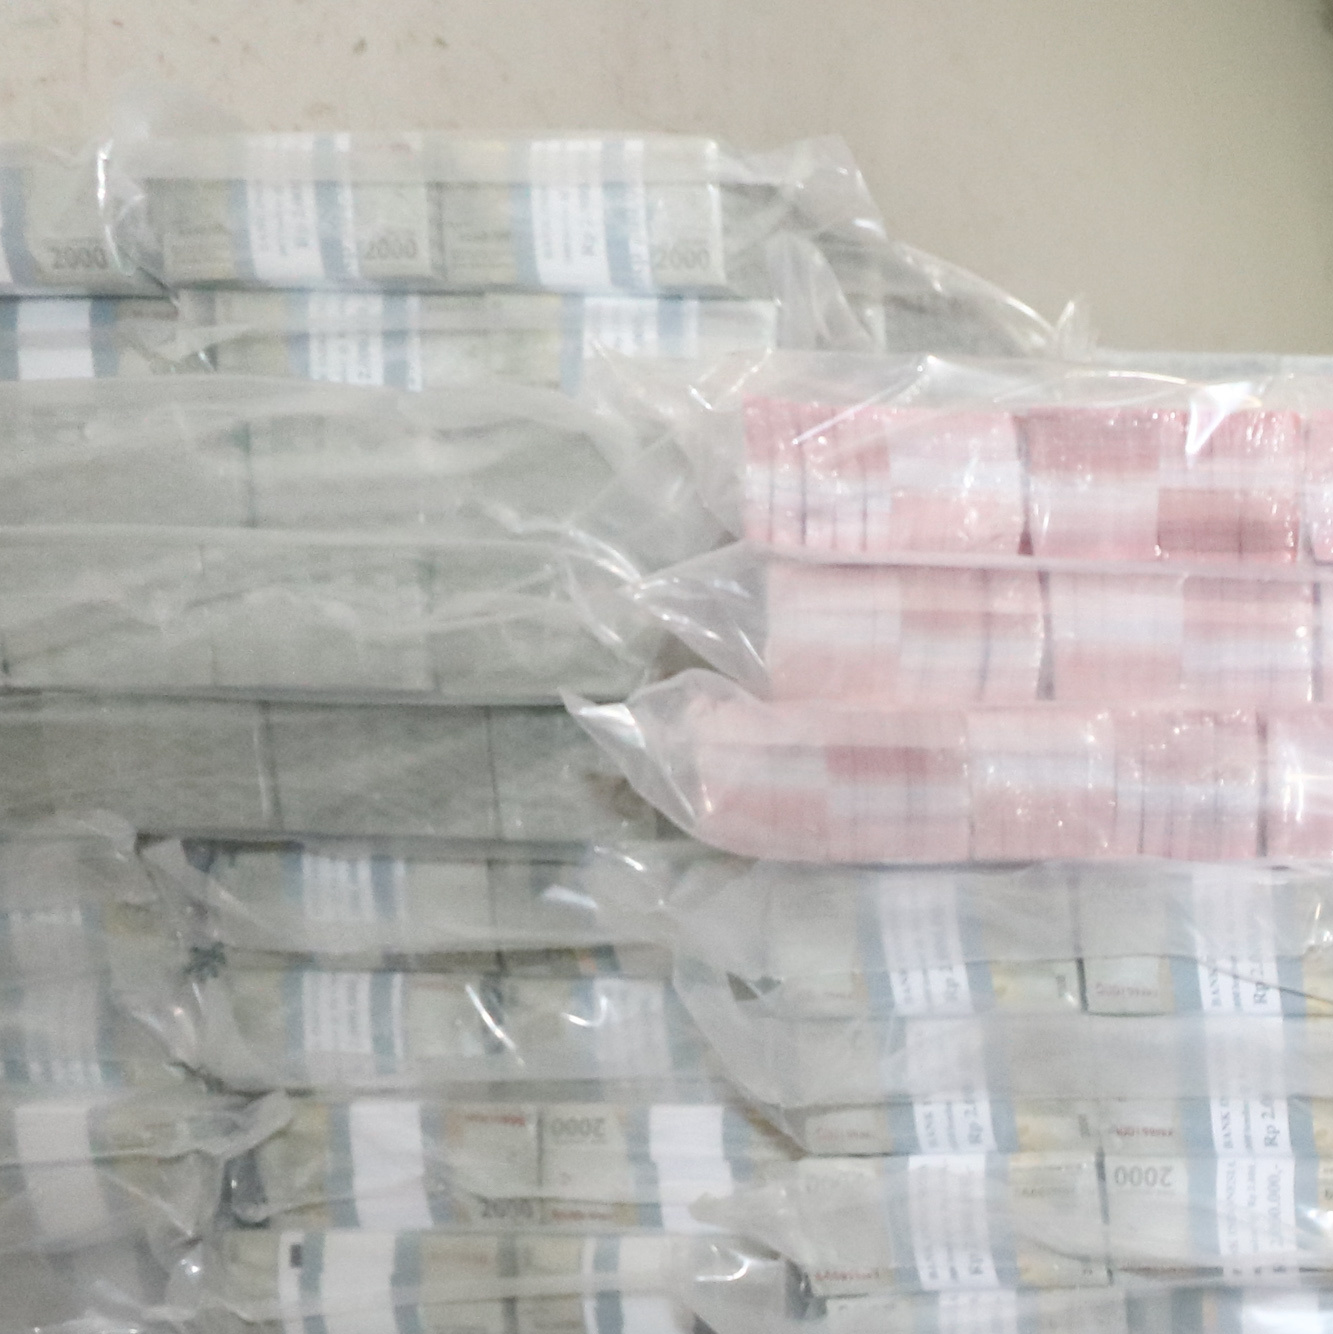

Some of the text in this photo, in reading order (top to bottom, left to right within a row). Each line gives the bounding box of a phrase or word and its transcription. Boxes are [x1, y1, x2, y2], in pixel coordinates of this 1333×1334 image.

[1221, 1112, 1234, 1149] BANK
[1264, 1123, 1280, 1147] Rp
[1113, 1166, 1173, 1187] 2000
